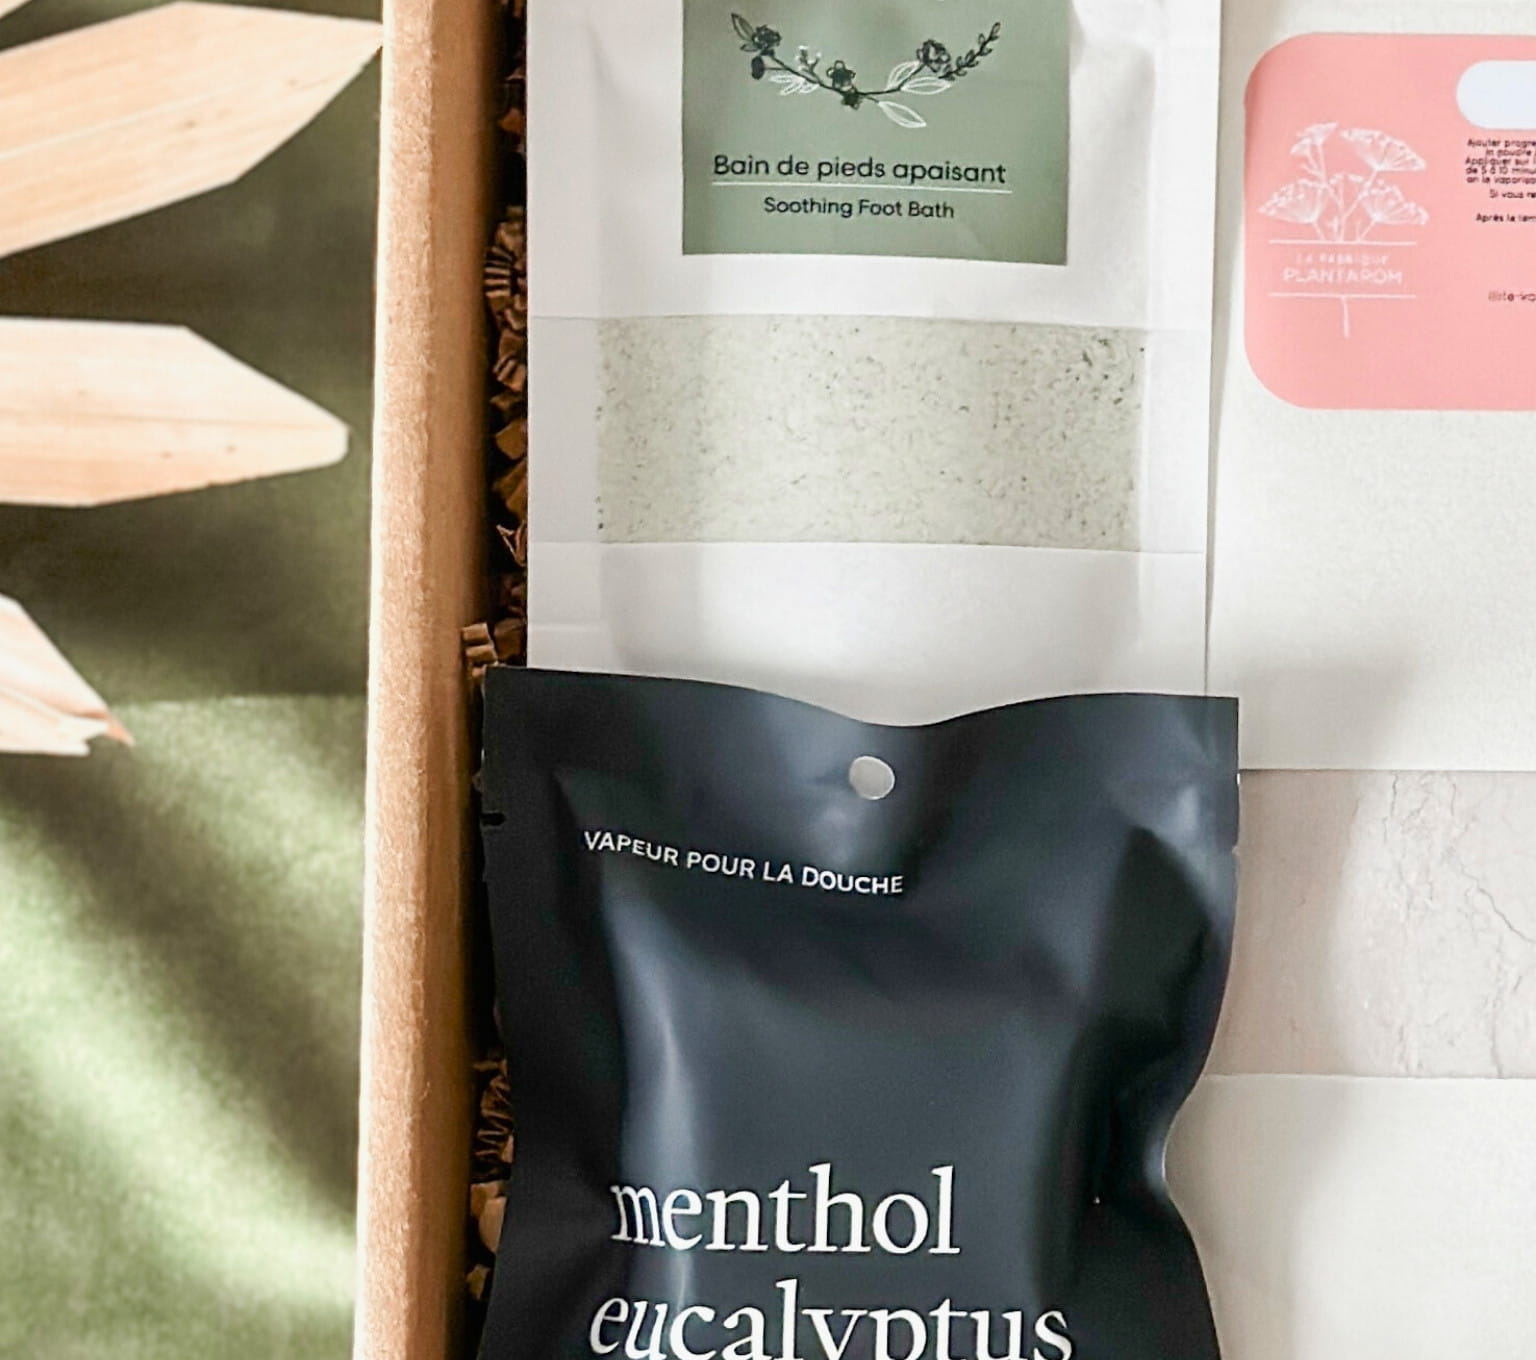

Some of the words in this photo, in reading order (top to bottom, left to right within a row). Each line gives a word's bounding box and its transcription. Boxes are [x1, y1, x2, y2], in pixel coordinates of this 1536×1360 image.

[713, 154, 770, 176] Bain
[777, 155, 809, 176] de
[817, 157, 886, 181] pieds
[892, 161, 1006, 184] apaisant
[763, 196, 853, 219] Soothing
[859, 199, 902, 218] Foot
[908, 200, 955, 219] Bath
[584, 830, 679, 867] VAPEUR
[686, 851, 756, 880] POUR
[762, 861, 794, 884] LA
[801, 866, 904, 895] DOUCHE
[610, 1162, 961, 1255] menthol
